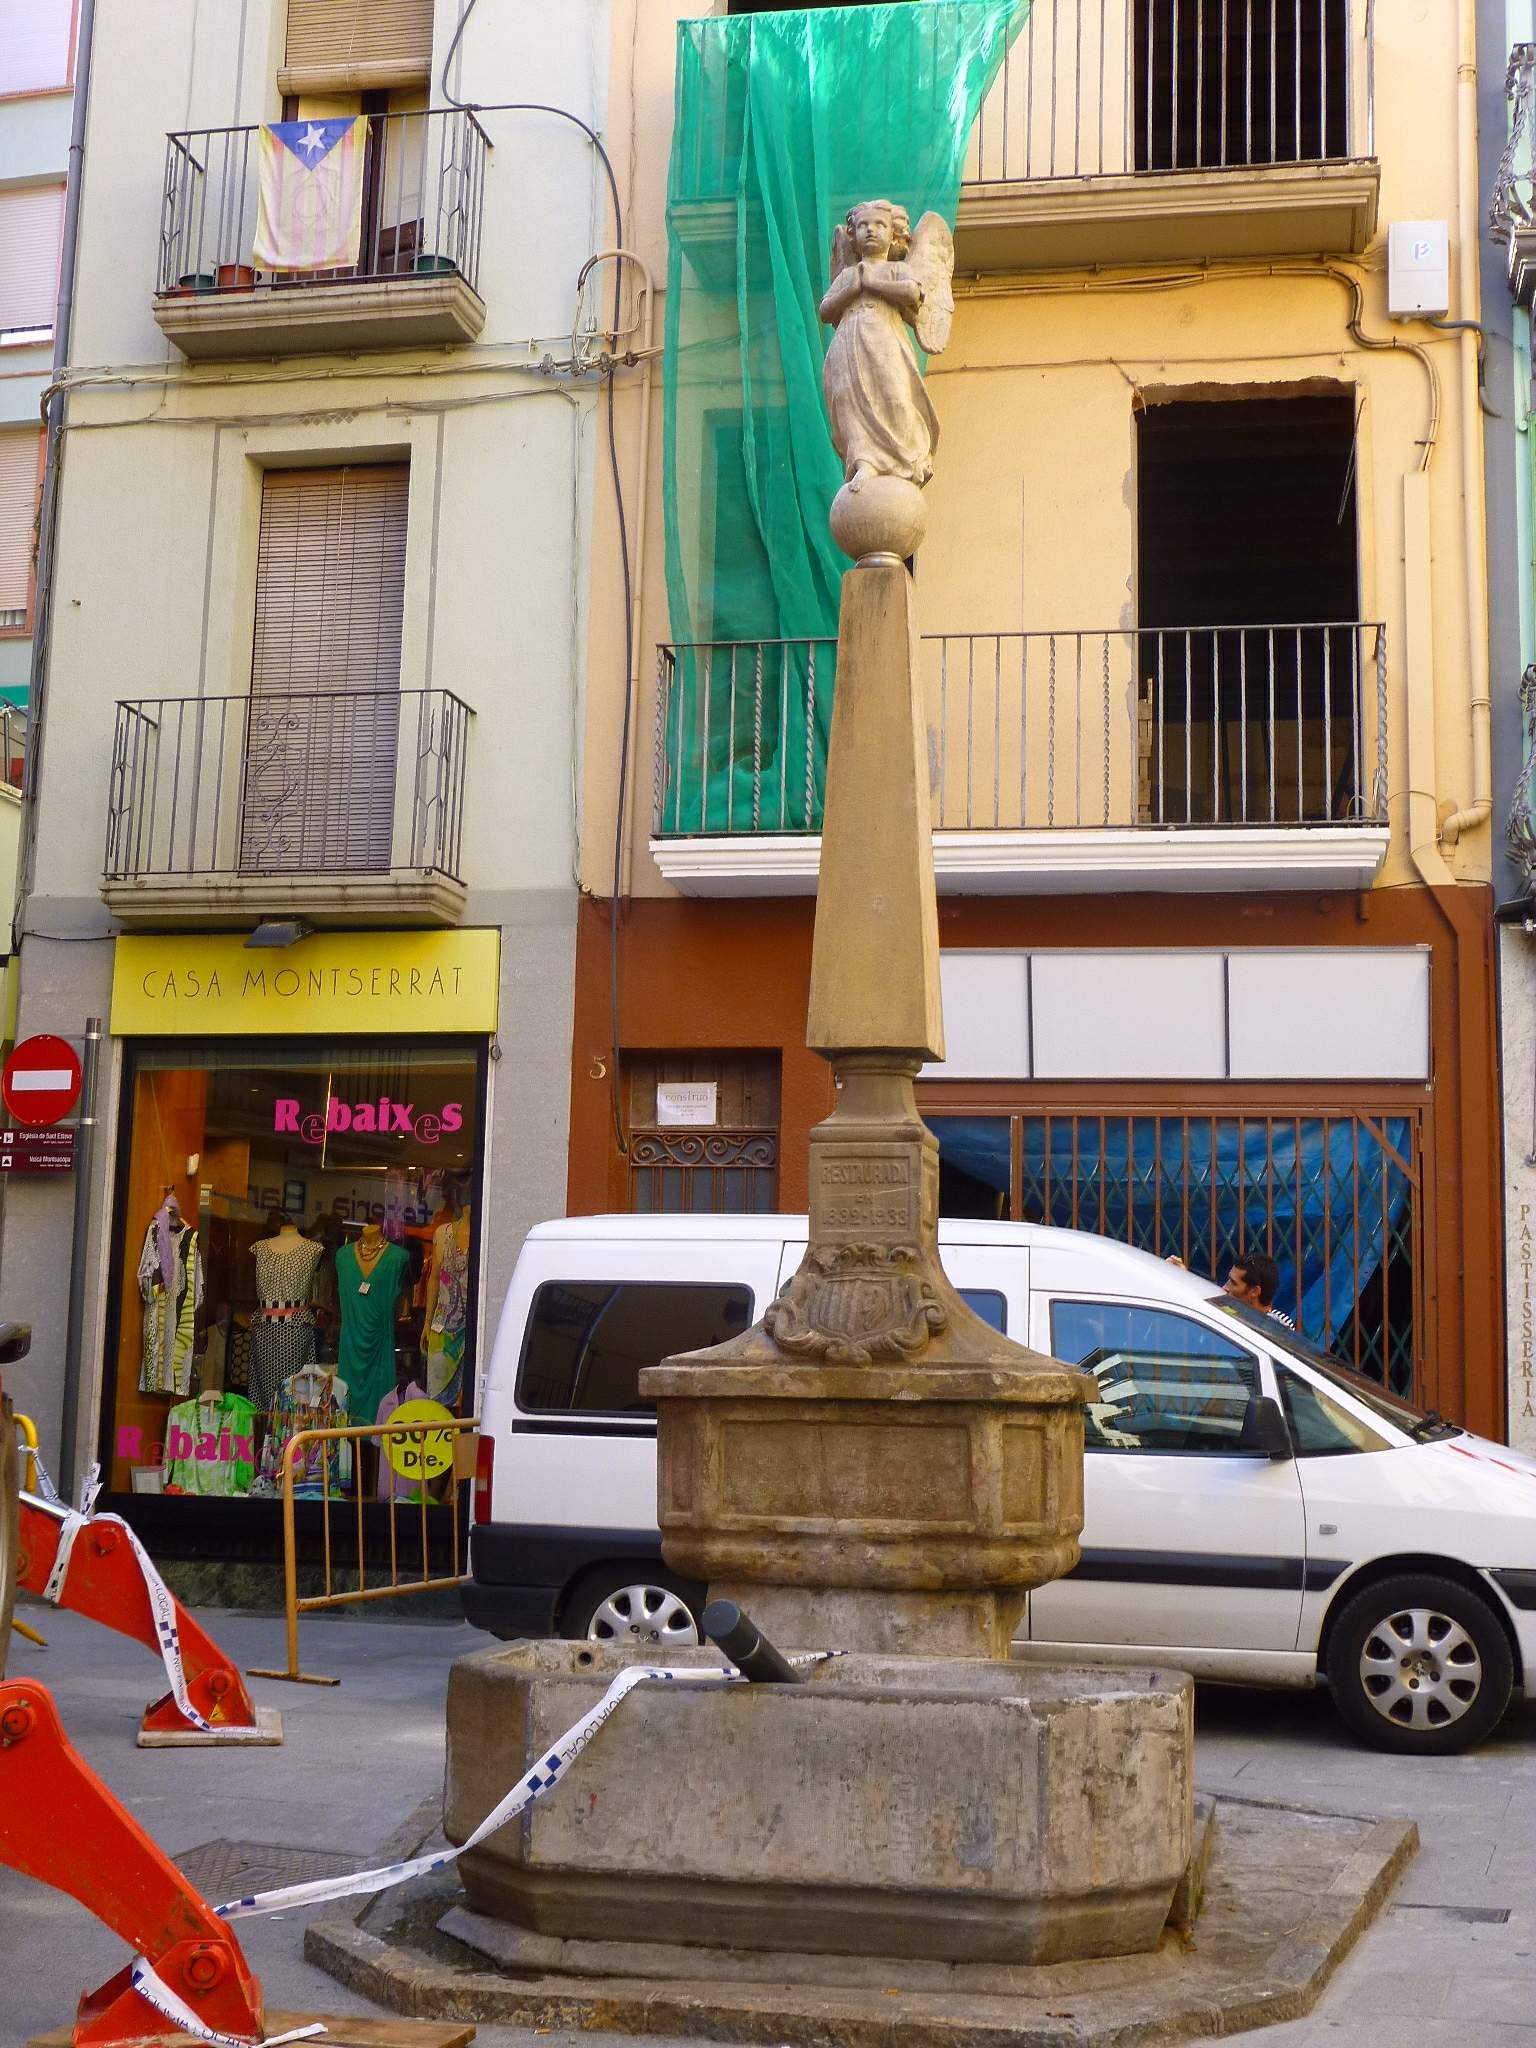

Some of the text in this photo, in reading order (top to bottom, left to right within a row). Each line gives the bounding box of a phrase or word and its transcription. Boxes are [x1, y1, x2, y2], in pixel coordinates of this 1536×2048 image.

[143, 966, 463, 998] CASA MONTSERRAT
[589, 1056, 606, 1079] 5
[274, 1097, 463, 1144] Rebaixes
[1519, 1204, 1535, 1418] PASTISSERIA
[560, 1718, 602, 1761] LOCAL
